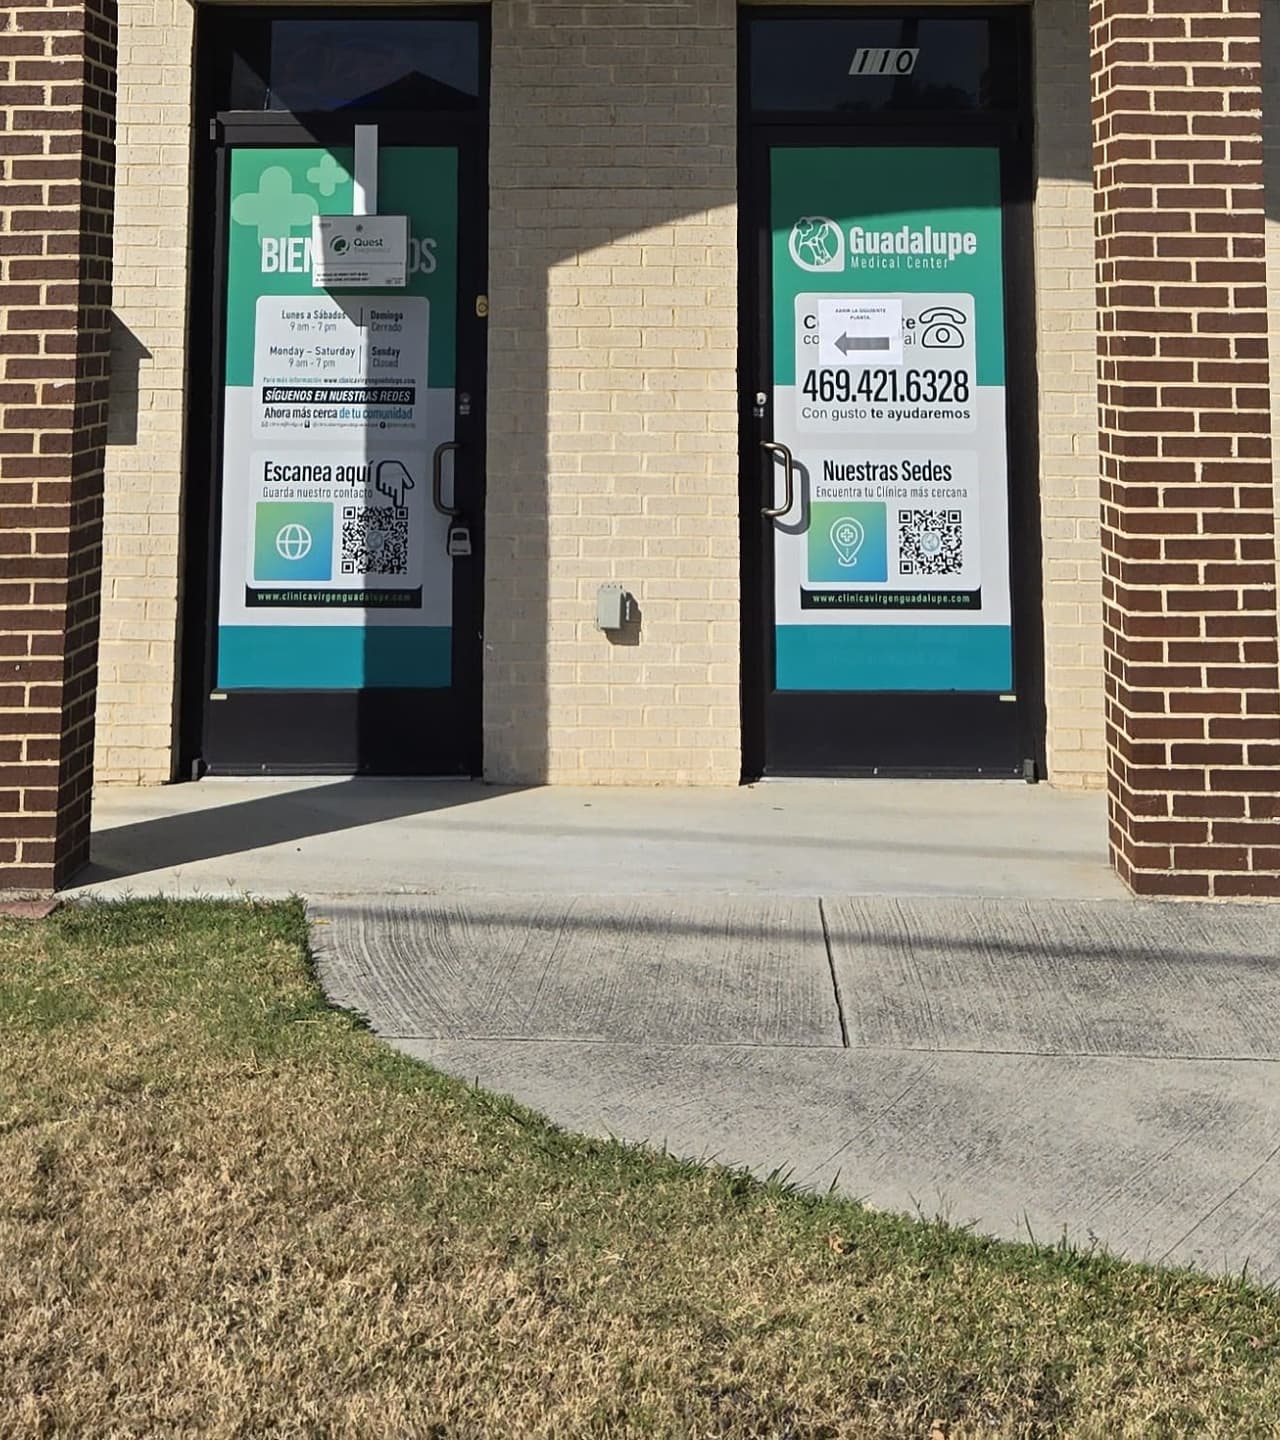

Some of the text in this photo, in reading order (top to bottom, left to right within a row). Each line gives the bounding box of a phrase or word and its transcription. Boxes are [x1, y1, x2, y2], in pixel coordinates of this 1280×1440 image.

[856, 49, 913, 73] 110
[354, 238, 384, 247] Quest
[850, 226, 977, 261] Guadalupe
[851, 256, 948, 269] Medical Center
[282, 310, 305, 319] Lunes
[314, 309, 346, 320] Sábados
[904, 332, 916, 345] al
[269, 346, 305, 358] Monday
[315, 346, 356, 358] Saturday
[802, 369, 970, 403] 469.421.6328
[265, 388, 411, 401] SÍGUENOS EN NUESTRAS REDES
[264, 407, 413, 419] Ahora más cerca de tu comunidad
[802, 407, 971, 421] Con gusto te ayudaremos
[264, 459, 374, 487] Escanea aquí
[823, 459, 952, 481] Nuestras Sedes
[263, 486, 373, 498] Guarda nuestro contacto
[816, 485, 968, 498] Encuentra tu Clínica más cercana
